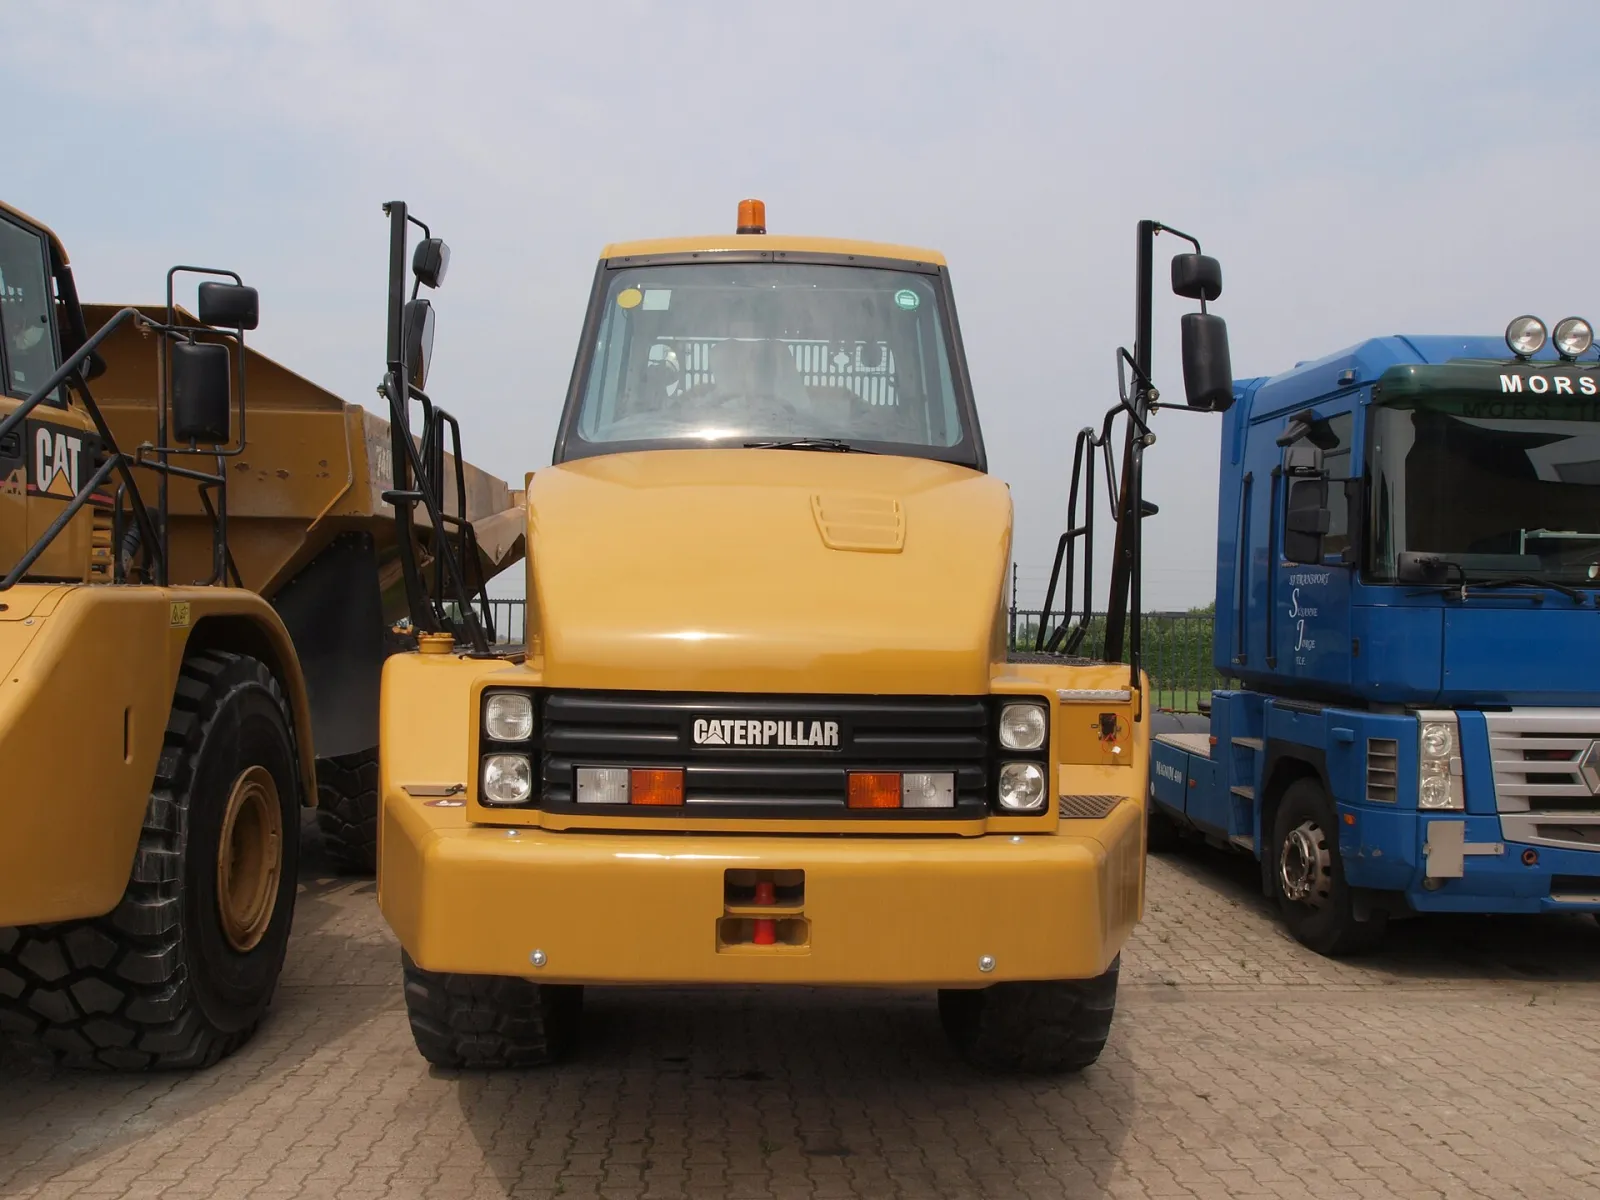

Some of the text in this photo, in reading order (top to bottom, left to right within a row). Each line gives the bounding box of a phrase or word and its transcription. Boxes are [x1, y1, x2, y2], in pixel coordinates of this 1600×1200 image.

[1500, 374, 1597, 395] MORS
[36, 427, 82, 498] CAT
[693, 719, 839, 746] CATERPILLAR
